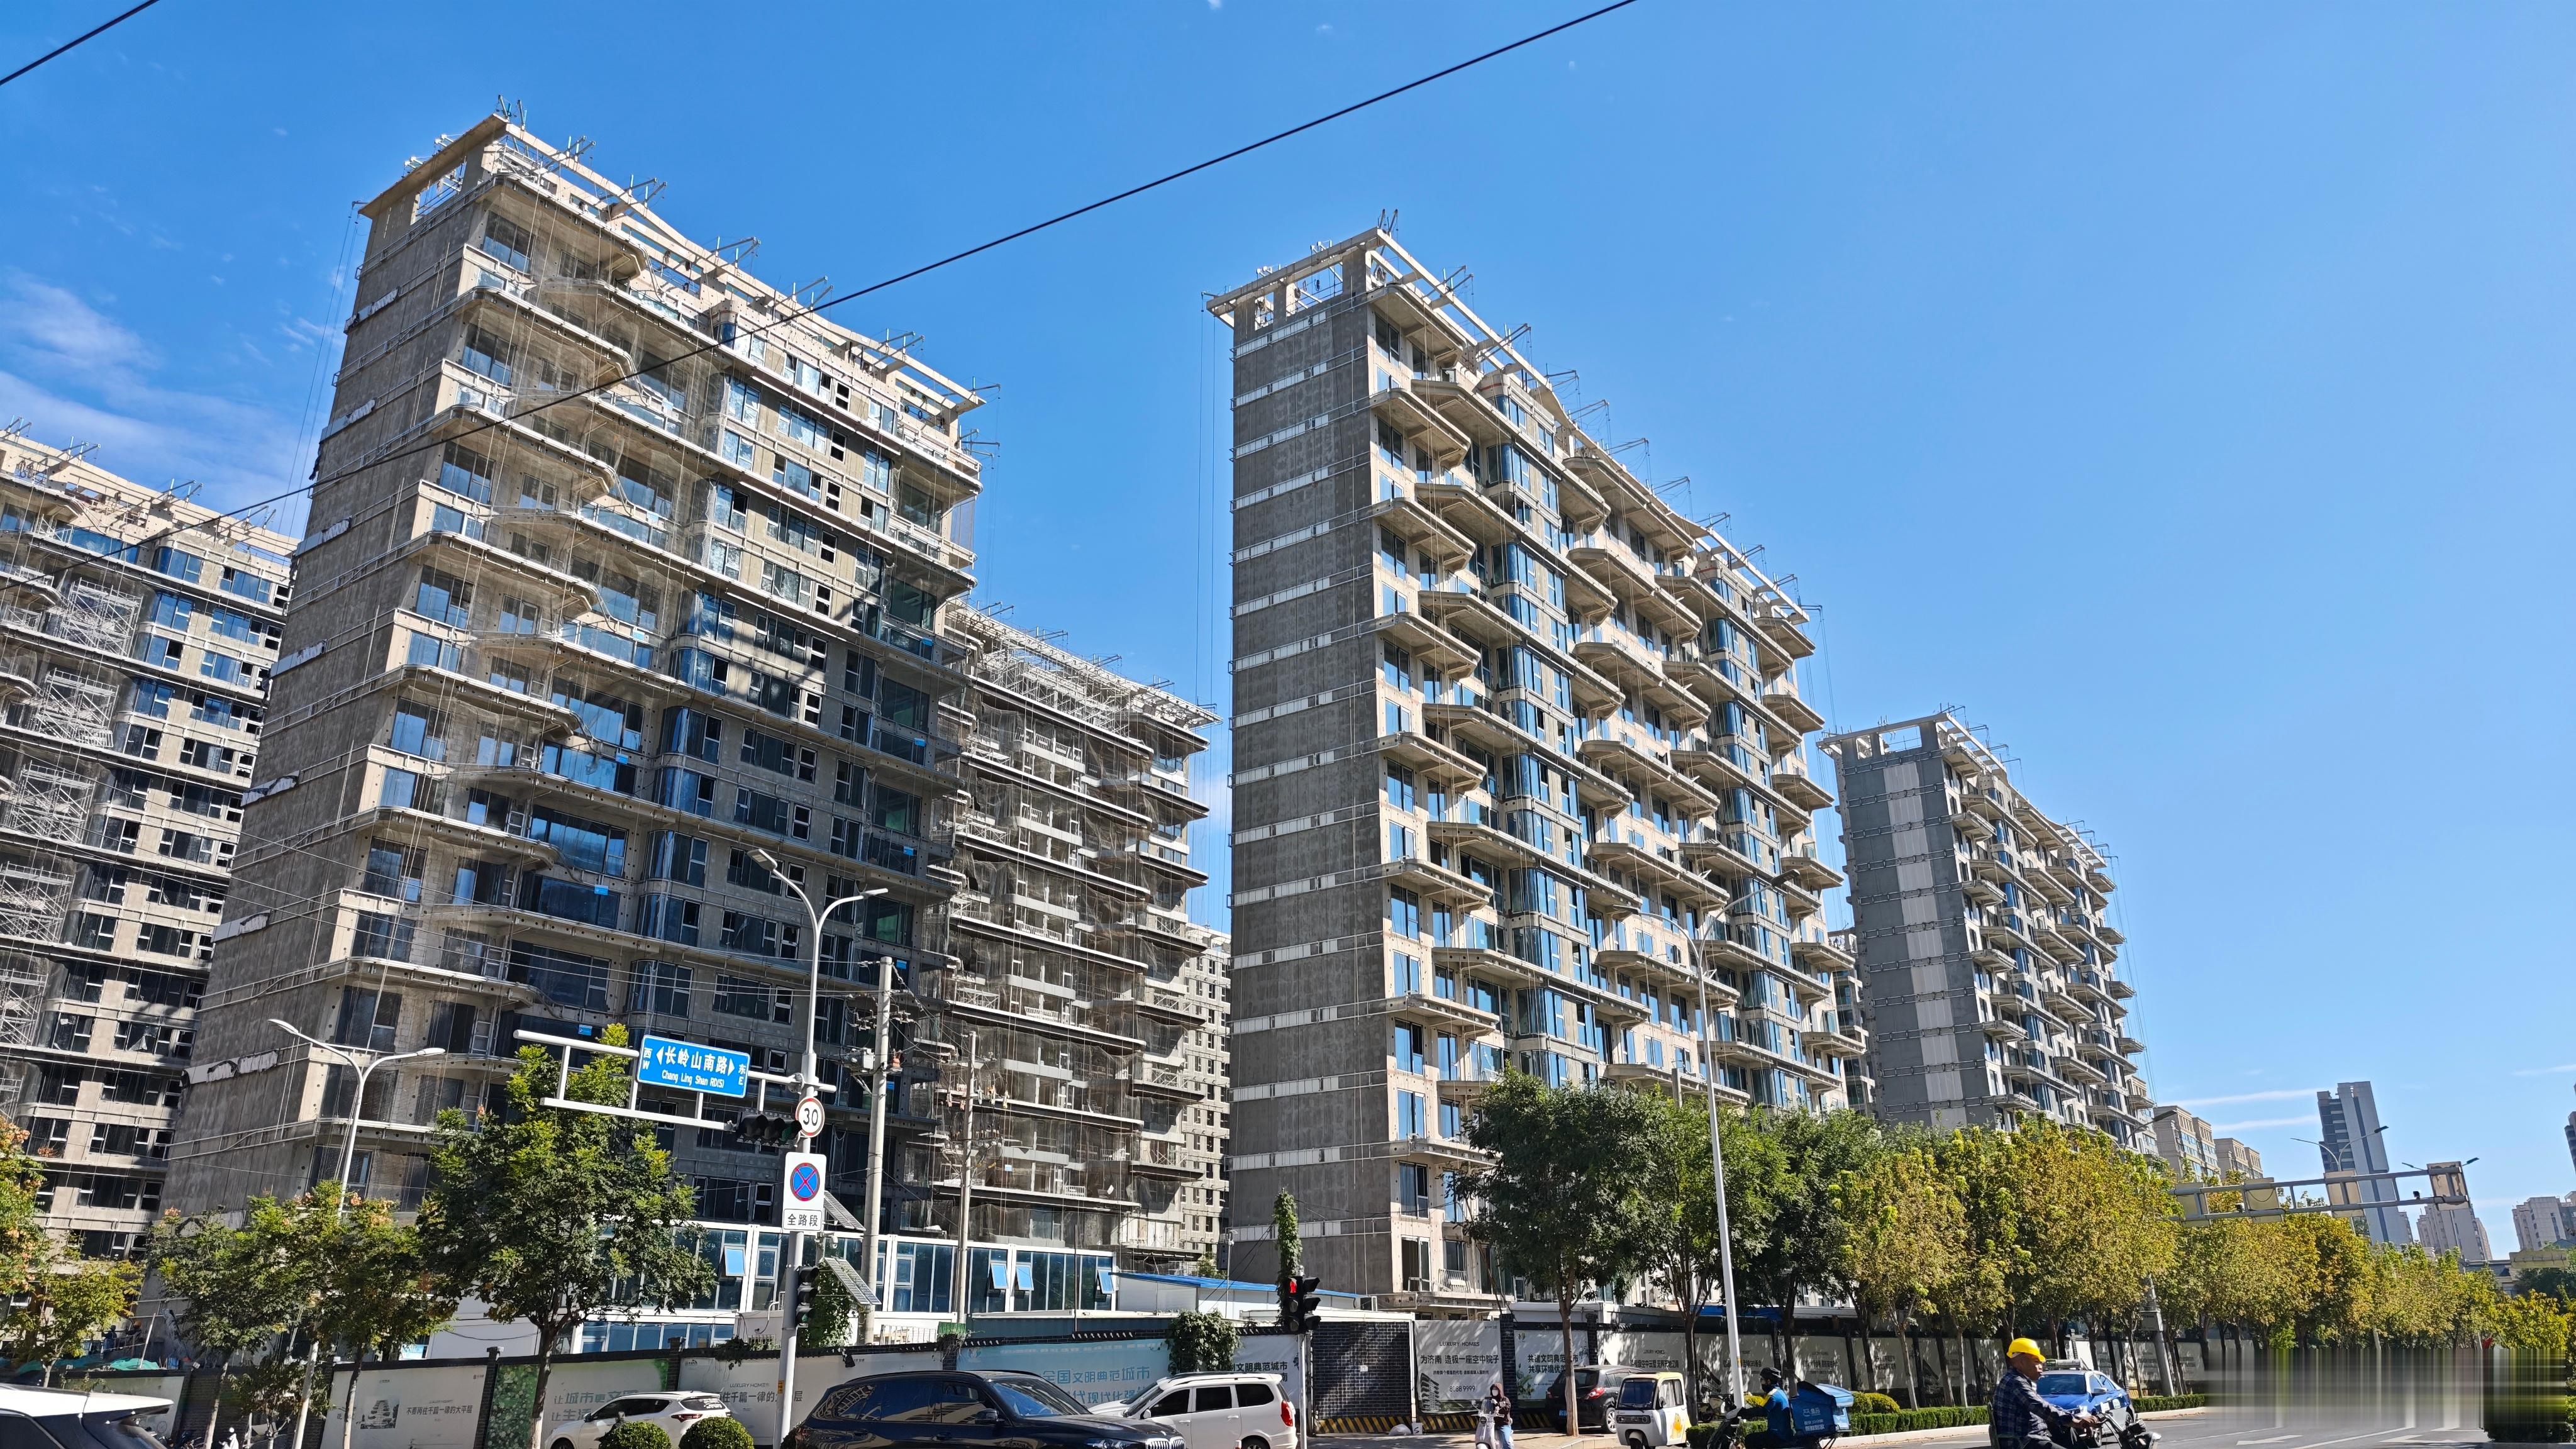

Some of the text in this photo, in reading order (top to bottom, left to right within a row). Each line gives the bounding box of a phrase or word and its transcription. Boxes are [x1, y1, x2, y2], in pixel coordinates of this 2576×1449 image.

[644, 1047, 652, 1058] 西
[643, 1060, 650, 1070] W
[665, 1045, 727, 1074] 长岭山南路
[738, 1063, 746, 1074] 东
[662, 1069, 724, 1089] Chang Ling Shan RD(S)
[738, 1077, 743, 1085] E
[803, 1108, 818, 1126] 30
[787, 1213, 818, 1226] 全路段
[1420, 1355, 1499, 1364] 为济南 造极一座空中院子
